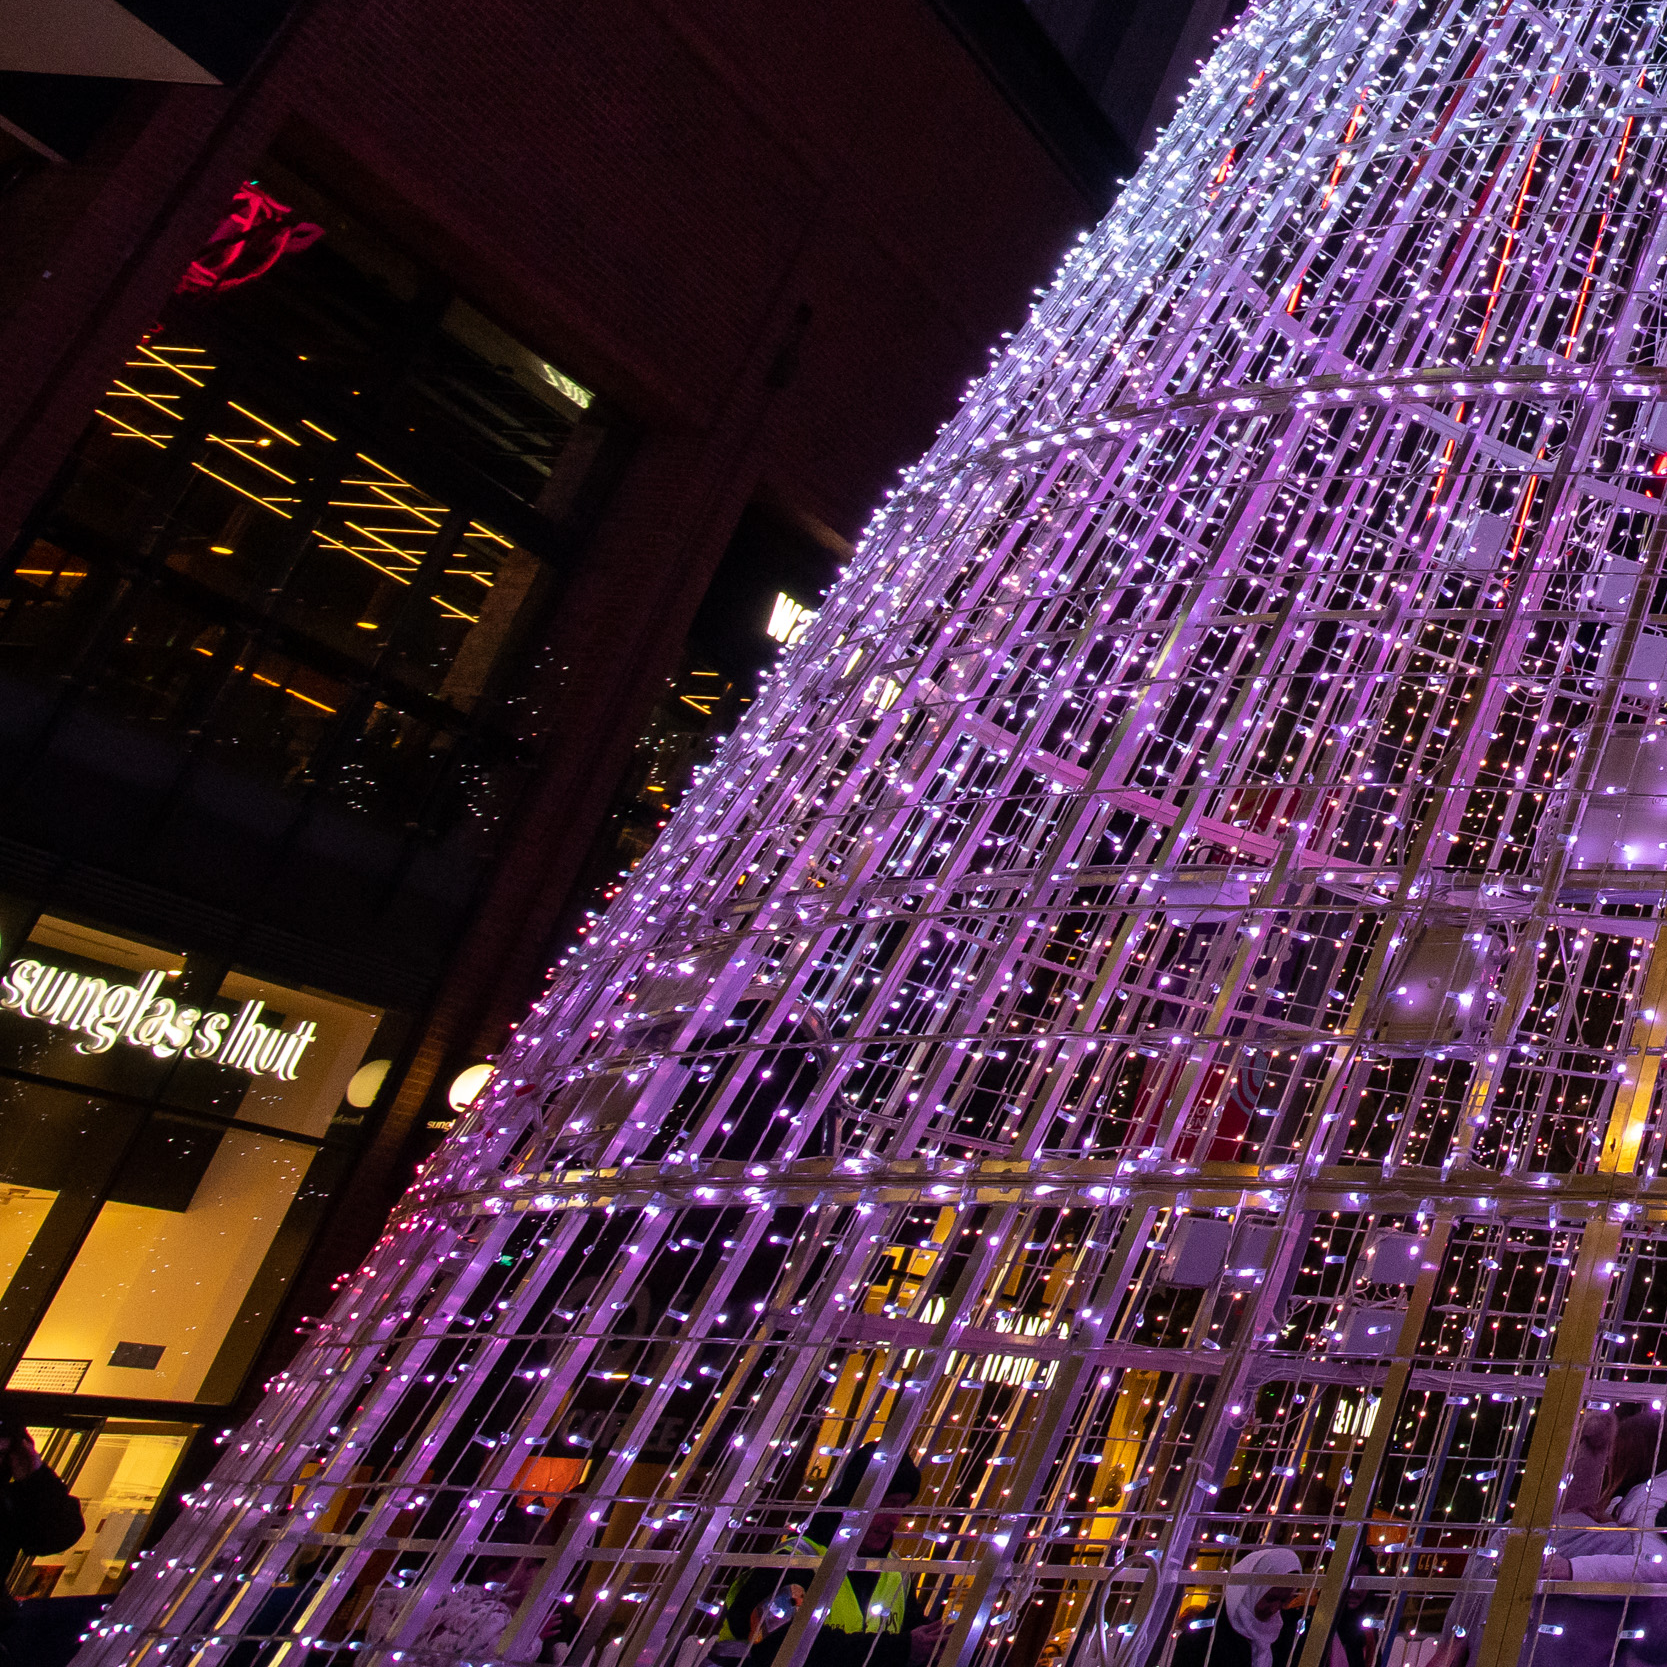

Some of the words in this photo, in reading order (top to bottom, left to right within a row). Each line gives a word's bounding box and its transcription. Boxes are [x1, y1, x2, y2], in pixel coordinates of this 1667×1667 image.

[0, 958, 230, 1059] sunglass
[217, 999, 318, 1081] hut
[557, 1408, 686, 1451] COFEE
